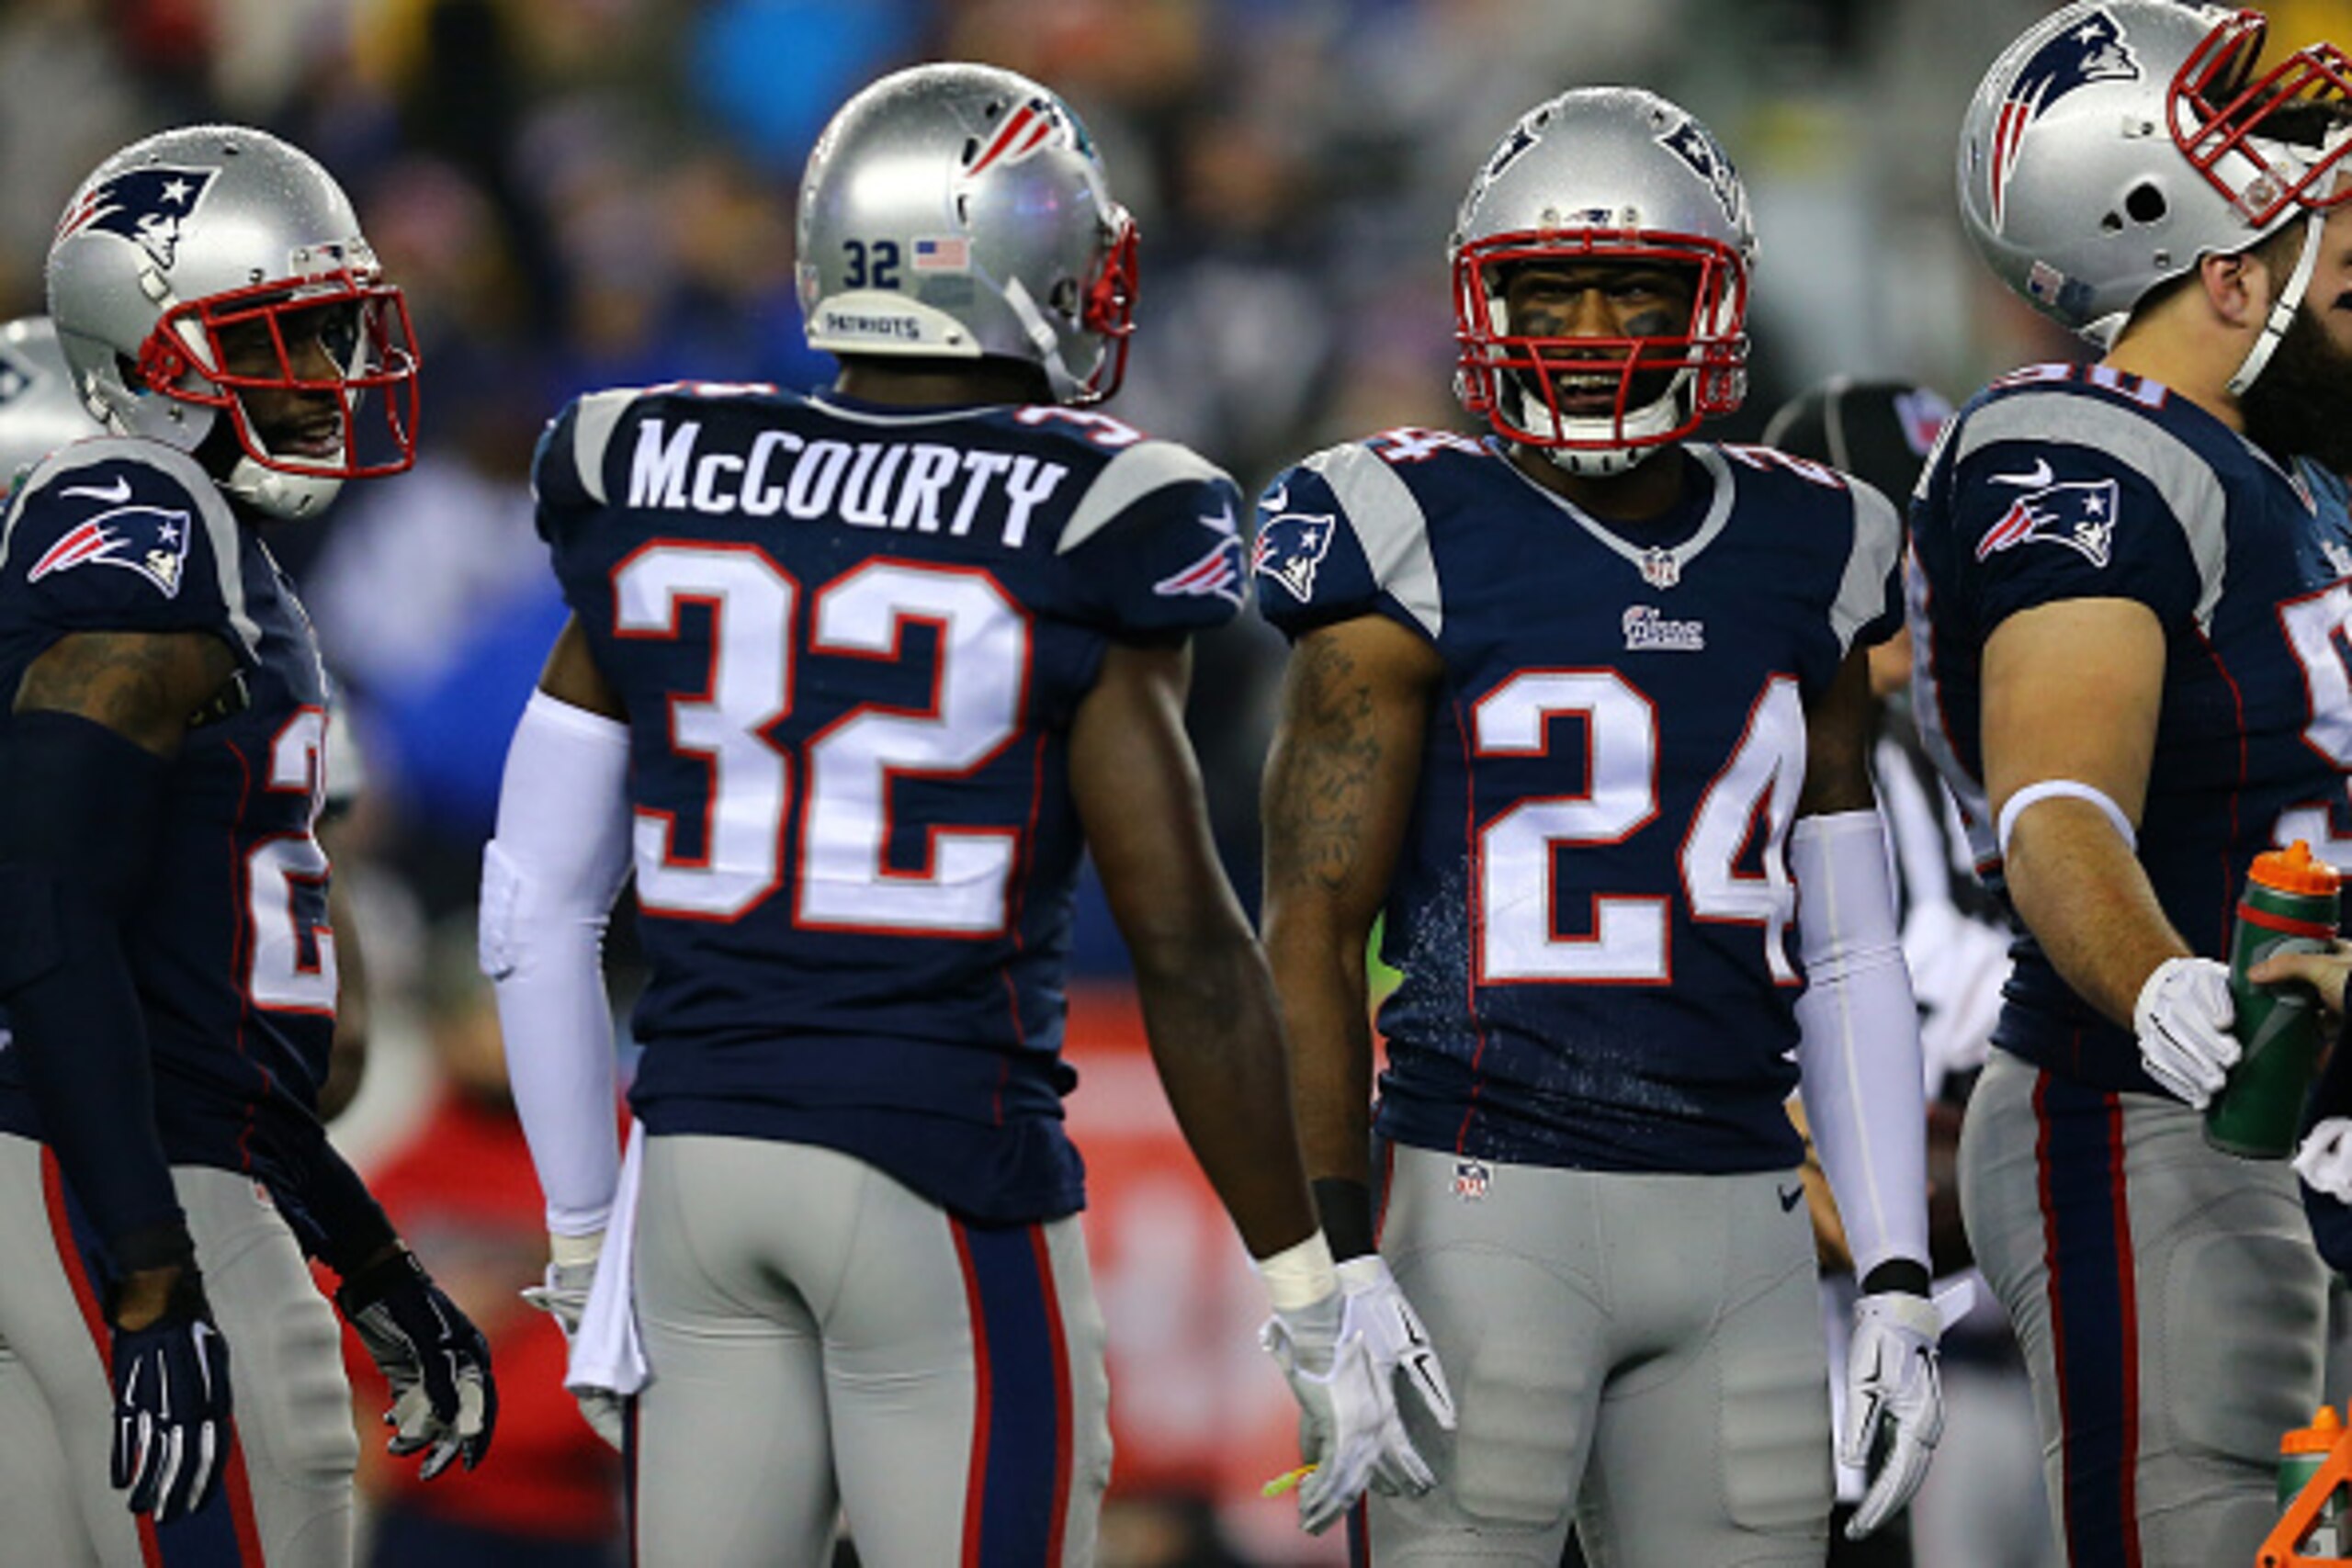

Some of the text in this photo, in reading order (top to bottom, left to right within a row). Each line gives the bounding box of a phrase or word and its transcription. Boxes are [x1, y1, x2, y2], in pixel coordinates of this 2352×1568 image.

[827, 311, 921, 340] PATRIOTS
[842, 240, 900, 289] 32
[628, 418, 1069, 548] McCOURTY
[609, 537, 1035, 941] 32
[1470, 665, 1804, 987] 24
